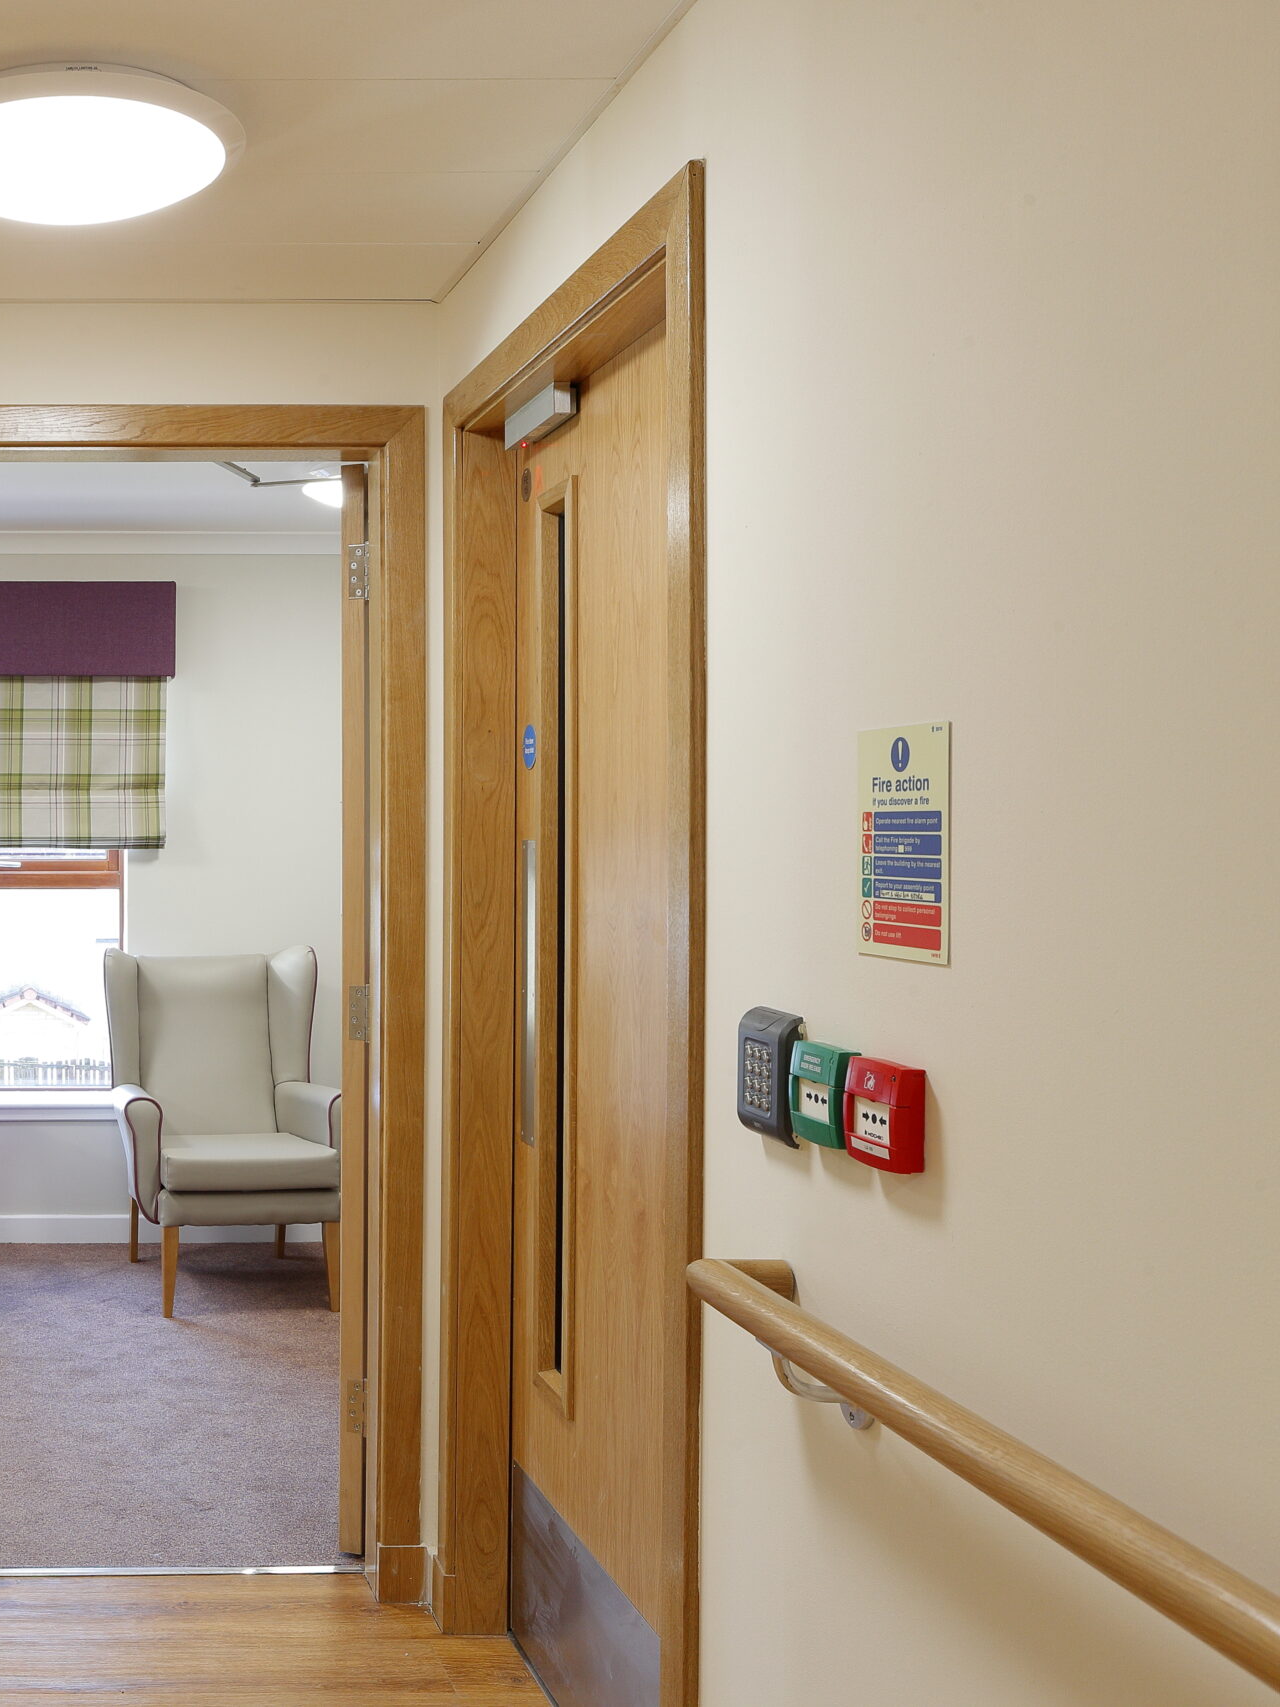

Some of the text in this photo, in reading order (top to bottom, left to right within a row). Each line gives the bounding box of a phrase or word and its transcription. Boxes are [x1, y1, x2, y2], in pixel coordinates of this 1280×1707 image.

[872, 775, 929, 792] Fire action
[877, 799, 887, 808] you
[889, 797, 912, 806] discover
[920, 796, 929, 805] fire
